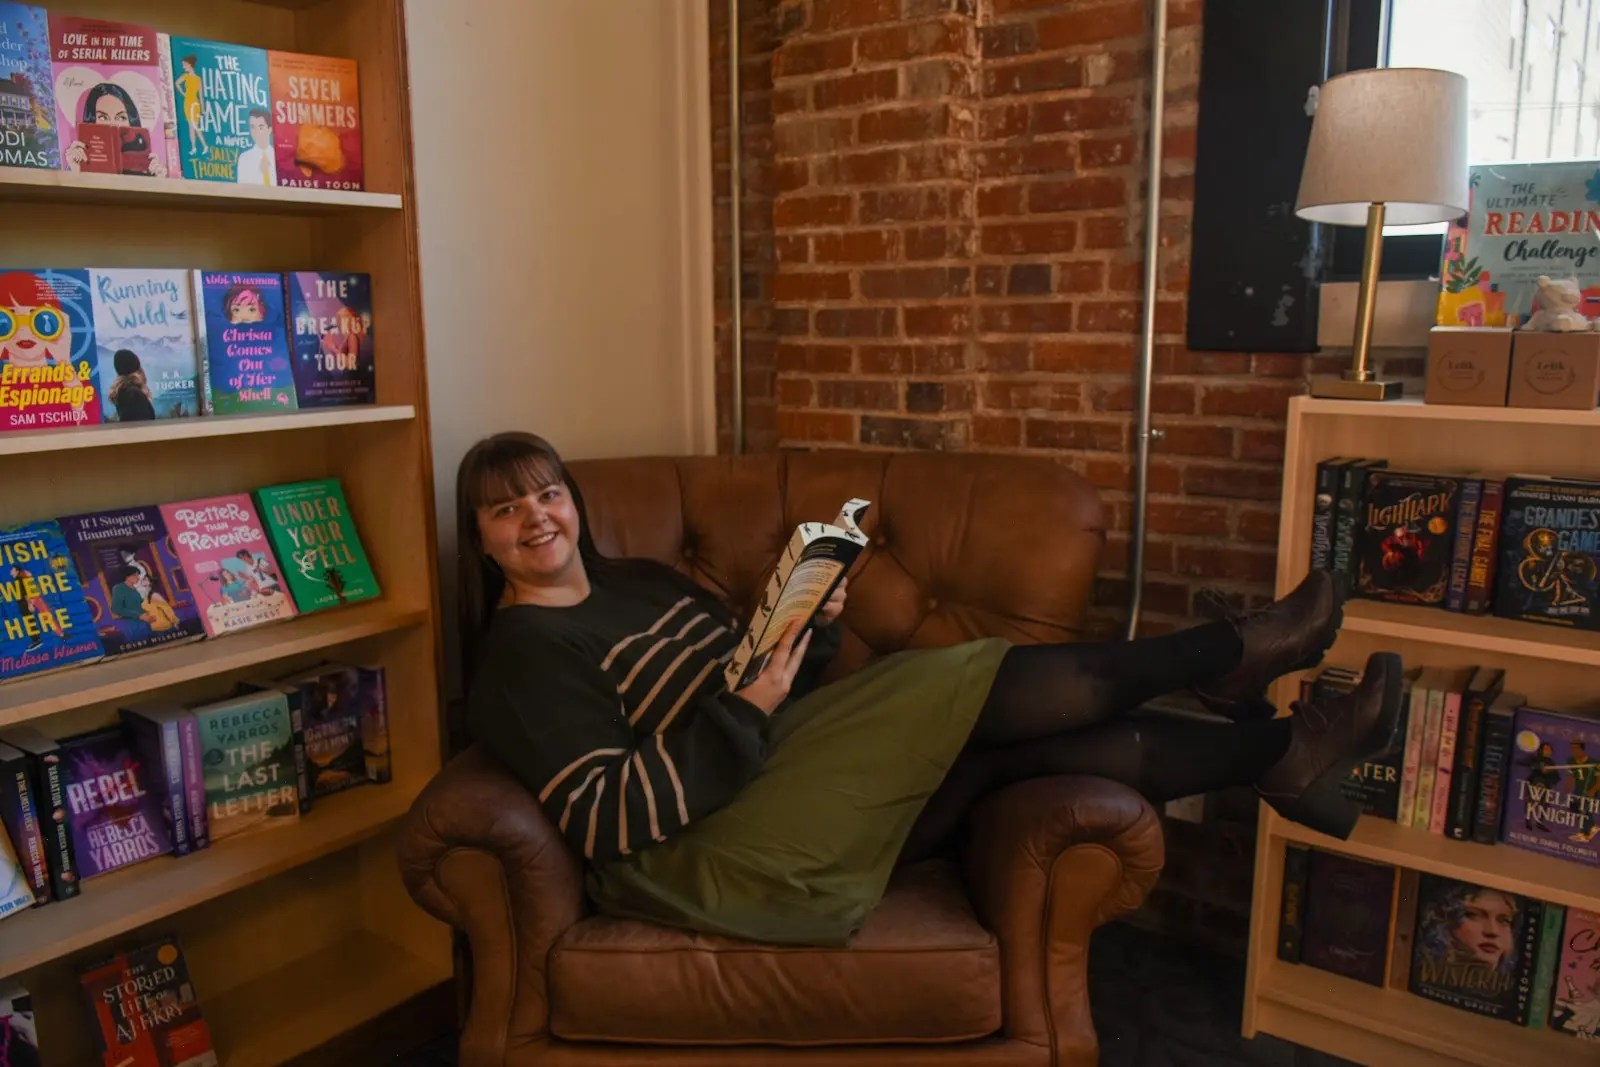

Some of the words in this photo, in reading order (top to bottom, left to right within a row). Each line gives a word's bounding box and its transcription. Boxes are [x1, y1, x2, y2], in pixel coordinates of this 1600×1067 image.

[63, 33, 88, 46] LOVE
[91, 37, 100, 46] IN
[102, 37, 116, 47] THE
[119, 36, 144, 48] TIME
[58, 49, 69, 59] OF
[72, 47, 107, 60] SERIAL
[111, 49, 150, 61] KILLERS
[214, 55, 241, 71] THE
[202, 67, 267, 107] HATING
[288, 75, 341, 102] SEVEN
[190, 100, 249, 136] GAME
[275, 100, 356, 129] SUMMERS
[215, 135, 223, 145] A
[224, 136, 252, 148] NOVEL
[209, 146, 239, 163] SALLY
[189, 158, 235, 179] THORNE
[281, 178, 319, 189] PAIGE
[325, 181, 360, 190] TOON
[1511, 182, 1536, 195] THE
[1486, 194, 1557, 209] ULTIMATE
[1503, 239, 1598, 268] Challenge
[97, 275, 179, 305] Running
[315, 280, 348, 298] THE
[109, 301, 168, 330] Wild
[295, 315, 371, 335] BREAKUP
[226, 343, 272, 357] Comes
[314, 353, 357, 371] TOUR
[1, 362, 75, 385] Errands
[78, 361, 91, 381] &
[238, 358, 263, 371] Out
[156, 379, 195, 390] TUCKER
[228, 374, 243, 389] of
[247, 373, 276, 387] Her
[0, 384, 95, 411] Espionage
[239, 387, 272, 402] Shell
[10, 413, 36, 425] SAM
[39, 410, 88, 424] TSCHIDA
[1511, 489, 1550, 499] JENNIFER
[1552, 493, 1576, 502] LYNN
[80, 519, 92, 529] If
[100, 512, 146, 525] Stopped
[272, 496, 342, 526] UNDER
[1364, 491, 1452, 532] LIGHTLARK
[78, 526, 133, 542] Haunting
[135, 523, 155, 533] You
[204, 522, 229, 532] THAN
[287, 520, 343, 548] YOUR
[0, 540, 48, 566] ISH
[291, 543, 356, 573] SPELL
[0, 572, 72, 603] WERE
[5, 608, 72, 640] HERE
[223, 617, 253, 629] KASIE
[255, 608, 281, 621] WEST
[1, 653, 49, 673] Melissa
[210, 707, 282, 730] REBECCA
[216, 722, 278, 744] YARROS
[226, 740, 272, 767] THE
[45, 764, 63, 807] VARIATION
[224, 763, 280, 792] LAST
[66, 768, 147, 815] REBEL
[212, 786, 294, 819] LETTER
[1516, 778, 1600, 814] TWELFTH
[1525, 800, 1589, 830] KNIGHT
[87, 815, 150, 849] REBECCA
[89, 831, 160, 870] YARROS
[124, 964, 146, 977] THE
[102, 965, 177, 1005] STORIED
[118, 992, 150, 1019] LIFE
[155, 989, 169, 1001] OF
[138, 1000, 183, 1032] FIKRY
